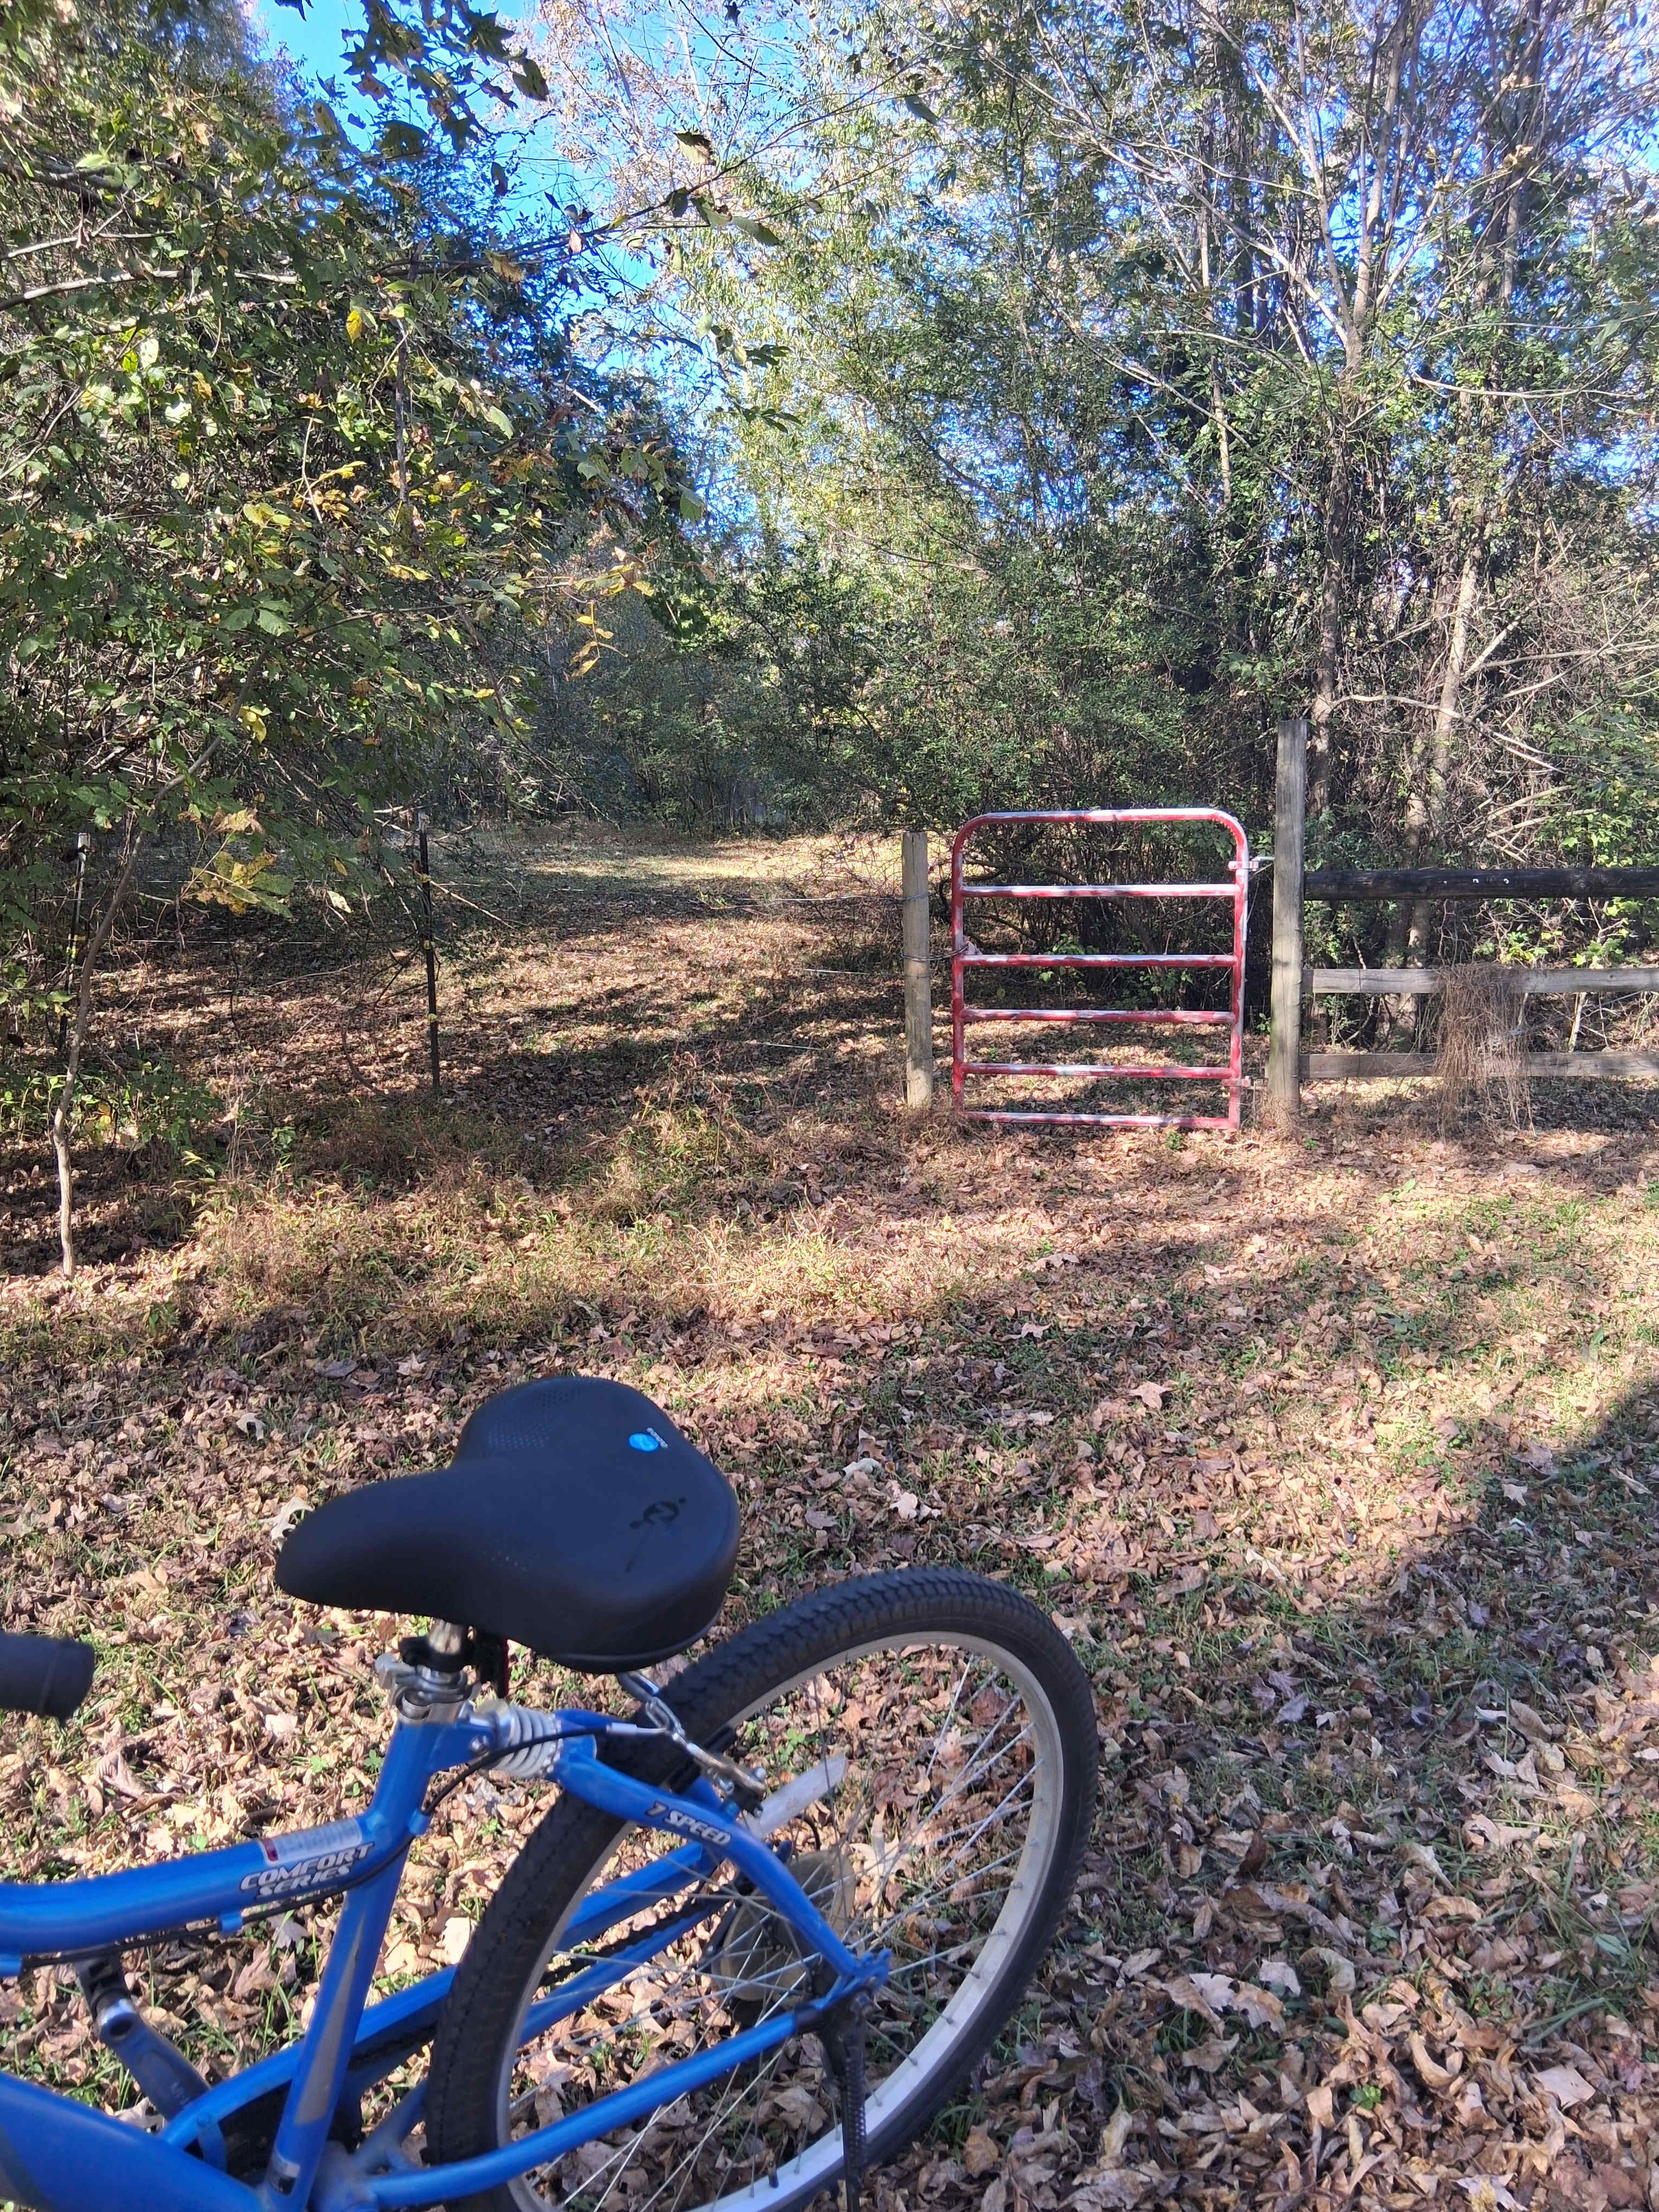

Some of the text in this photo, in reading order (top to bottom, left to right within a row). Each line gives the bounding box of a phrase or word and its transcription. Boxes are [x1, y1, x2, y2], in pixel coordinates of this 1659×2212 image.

[646, 1801, 731, 1845] 7 SPEED
[240, 1842, 374, 1891] COMFORT
[255, 1863, 352, 1899] SERIES
